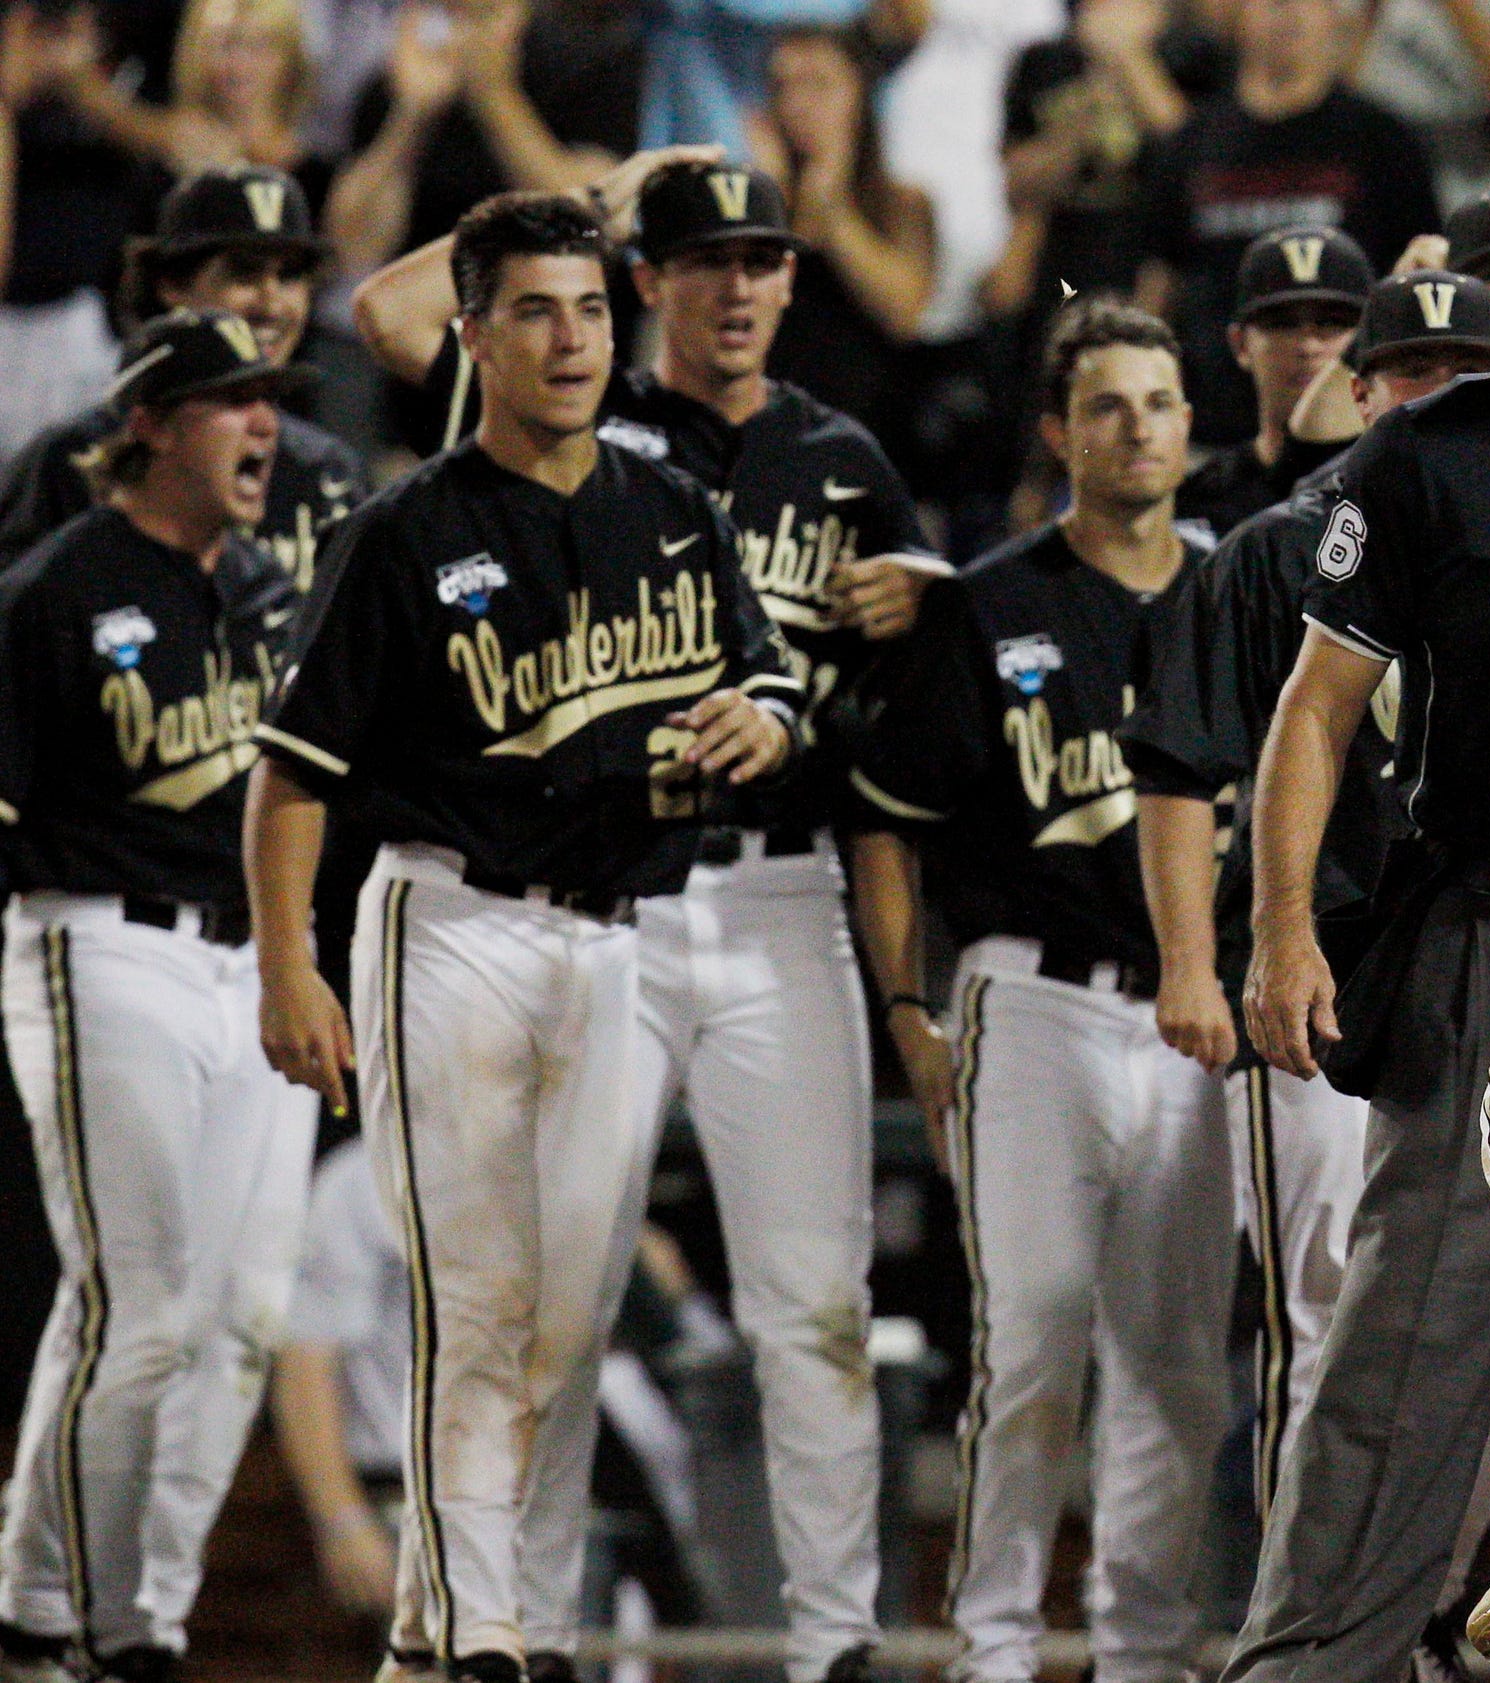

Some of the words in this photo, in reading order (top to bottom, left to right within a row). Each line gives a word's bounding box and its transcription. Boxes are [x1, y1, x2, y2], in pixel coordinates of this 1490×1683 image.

[244, 184, 285, 231] V
[710, 172, 748, 221] V
[1283, 237, 1325, 281] V
[1413, 283, 1457, 329] V
[214, 316, 258, 362] V
[1316, 500, 1367, 582] 6
[447, 570, 723, 733] Vanderbilt
